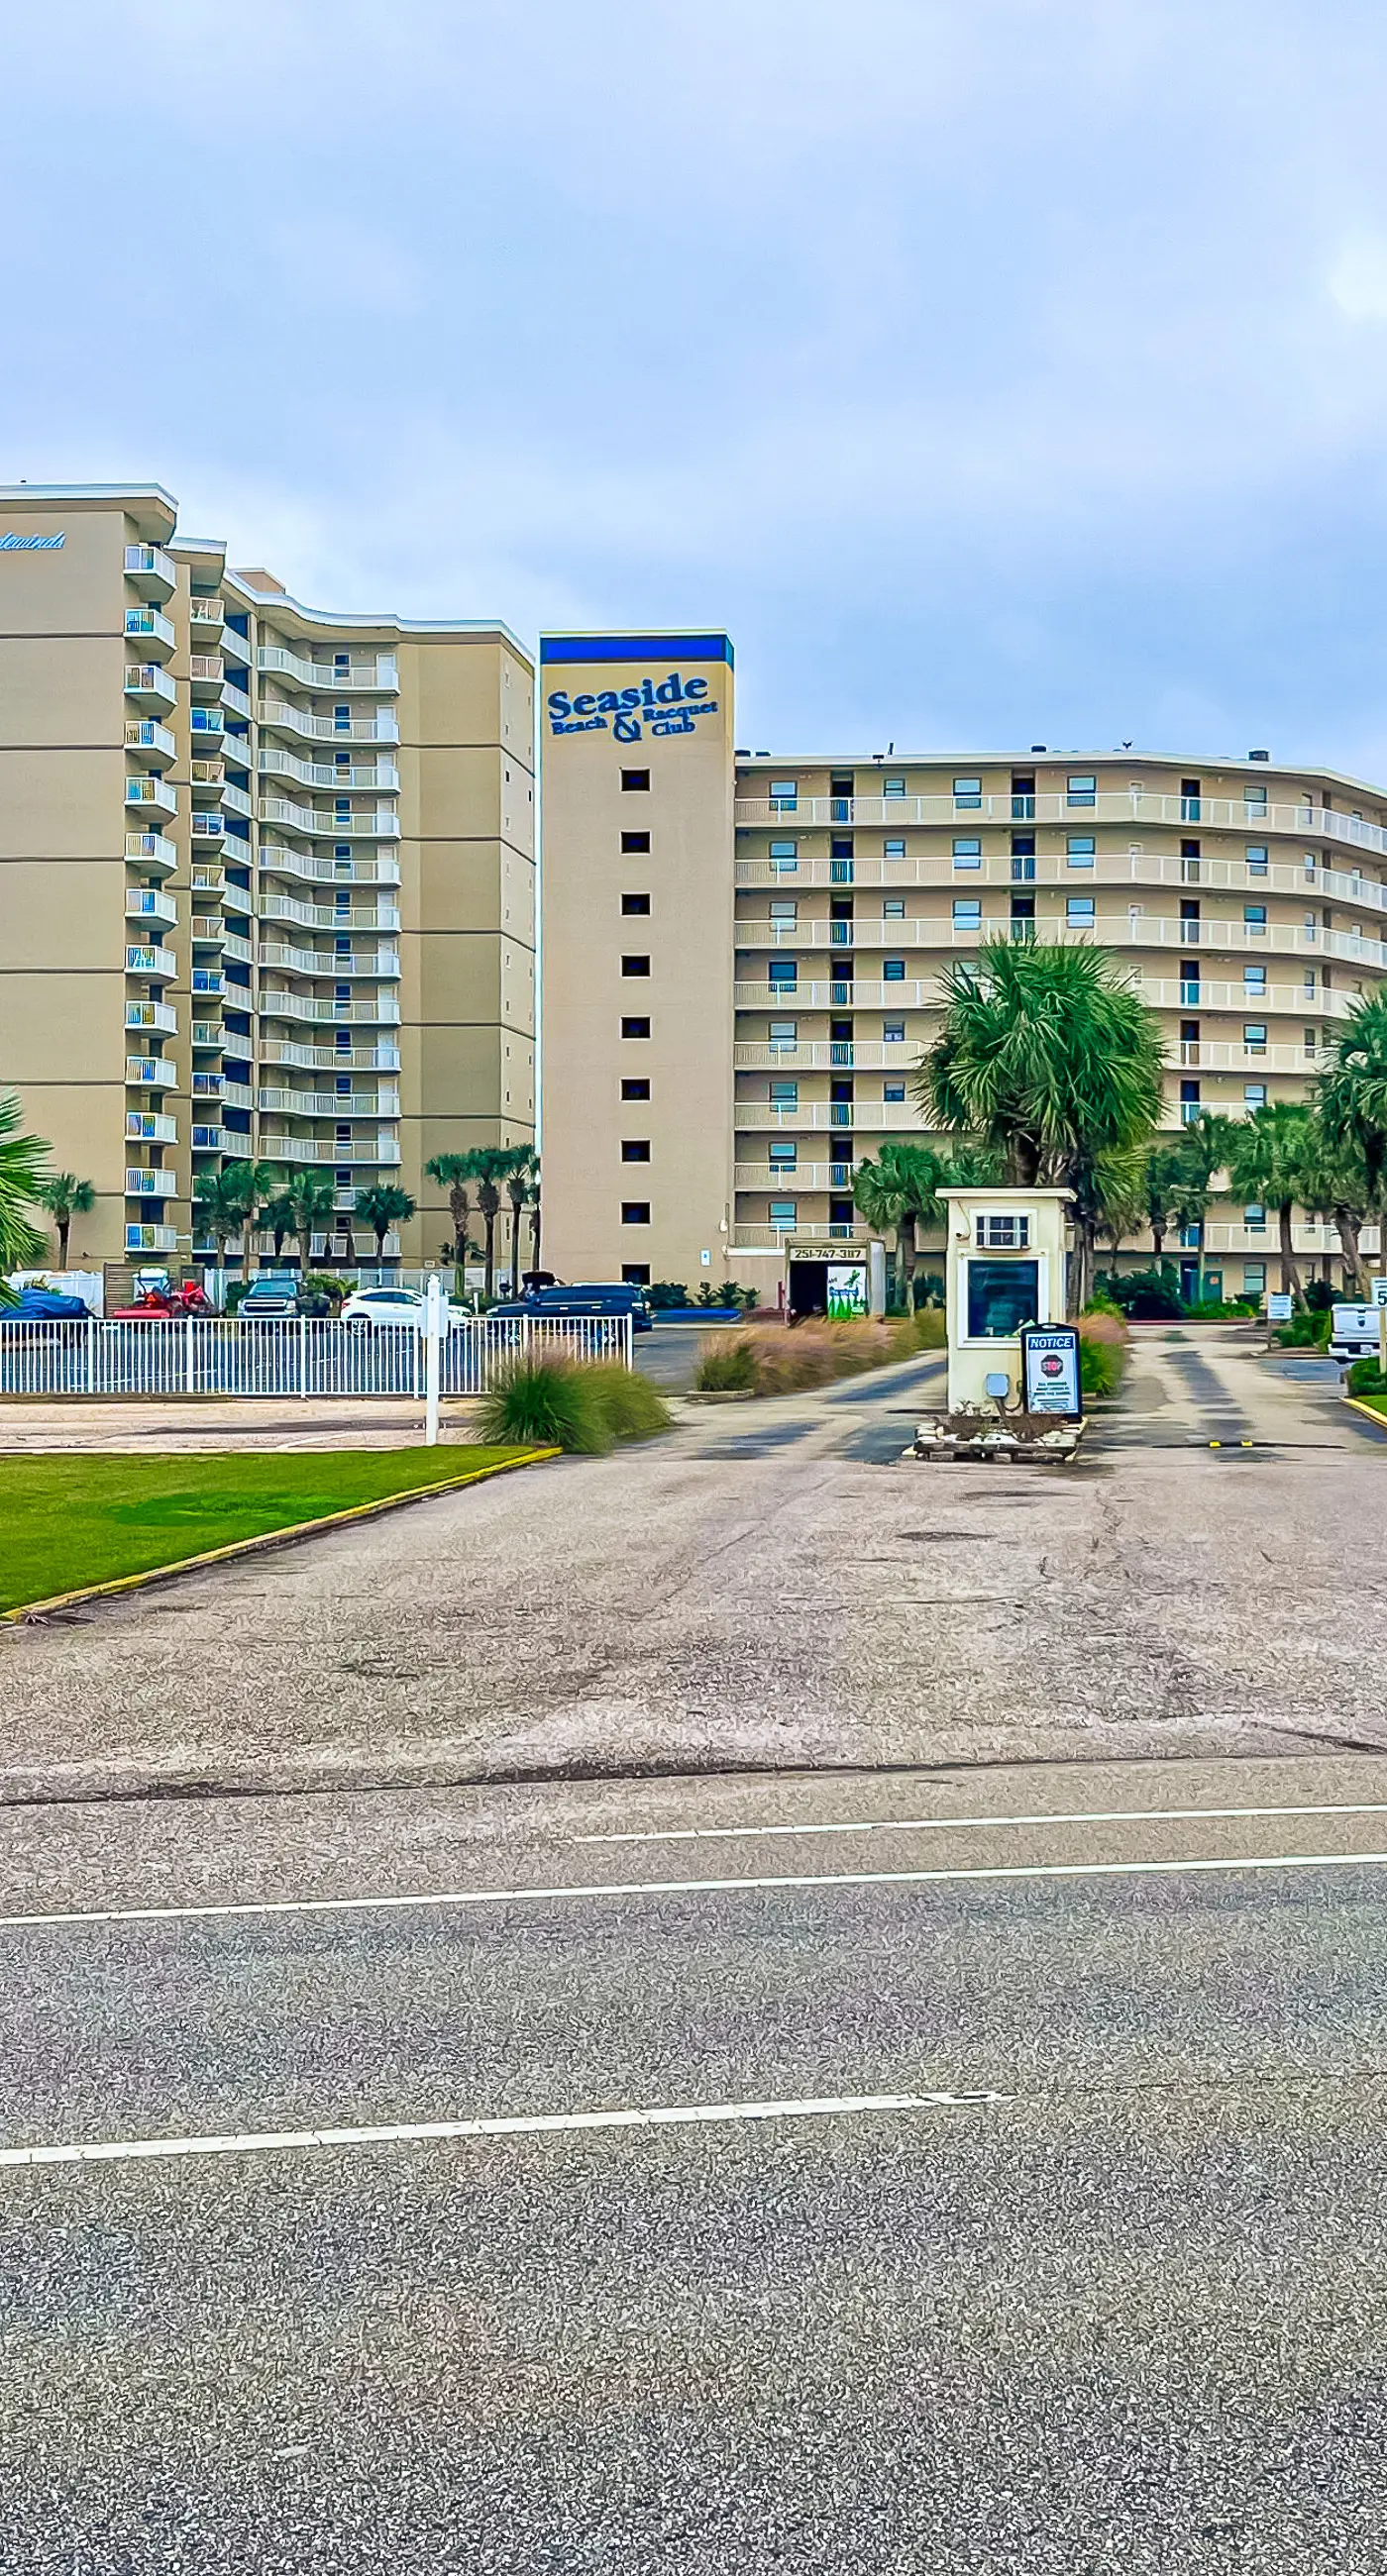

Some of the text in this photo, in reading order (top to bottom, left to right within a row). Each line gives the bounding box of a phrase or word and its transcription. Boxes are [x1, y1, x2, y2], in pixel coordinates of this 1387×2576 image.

[547, 672, 708, 720] Seaside
[642, 701, 718, 724] Racquet
[552, 715, 608, 735] Beach
[613, 711, 642, 743] &
[651, 717, 695, 736] Club
[795, 1249, 861, 1259] 251-747-3117
[1030, 1337, 1072, 1348] NOTICE
[1041, 1361, 1063, 1372] STOP
